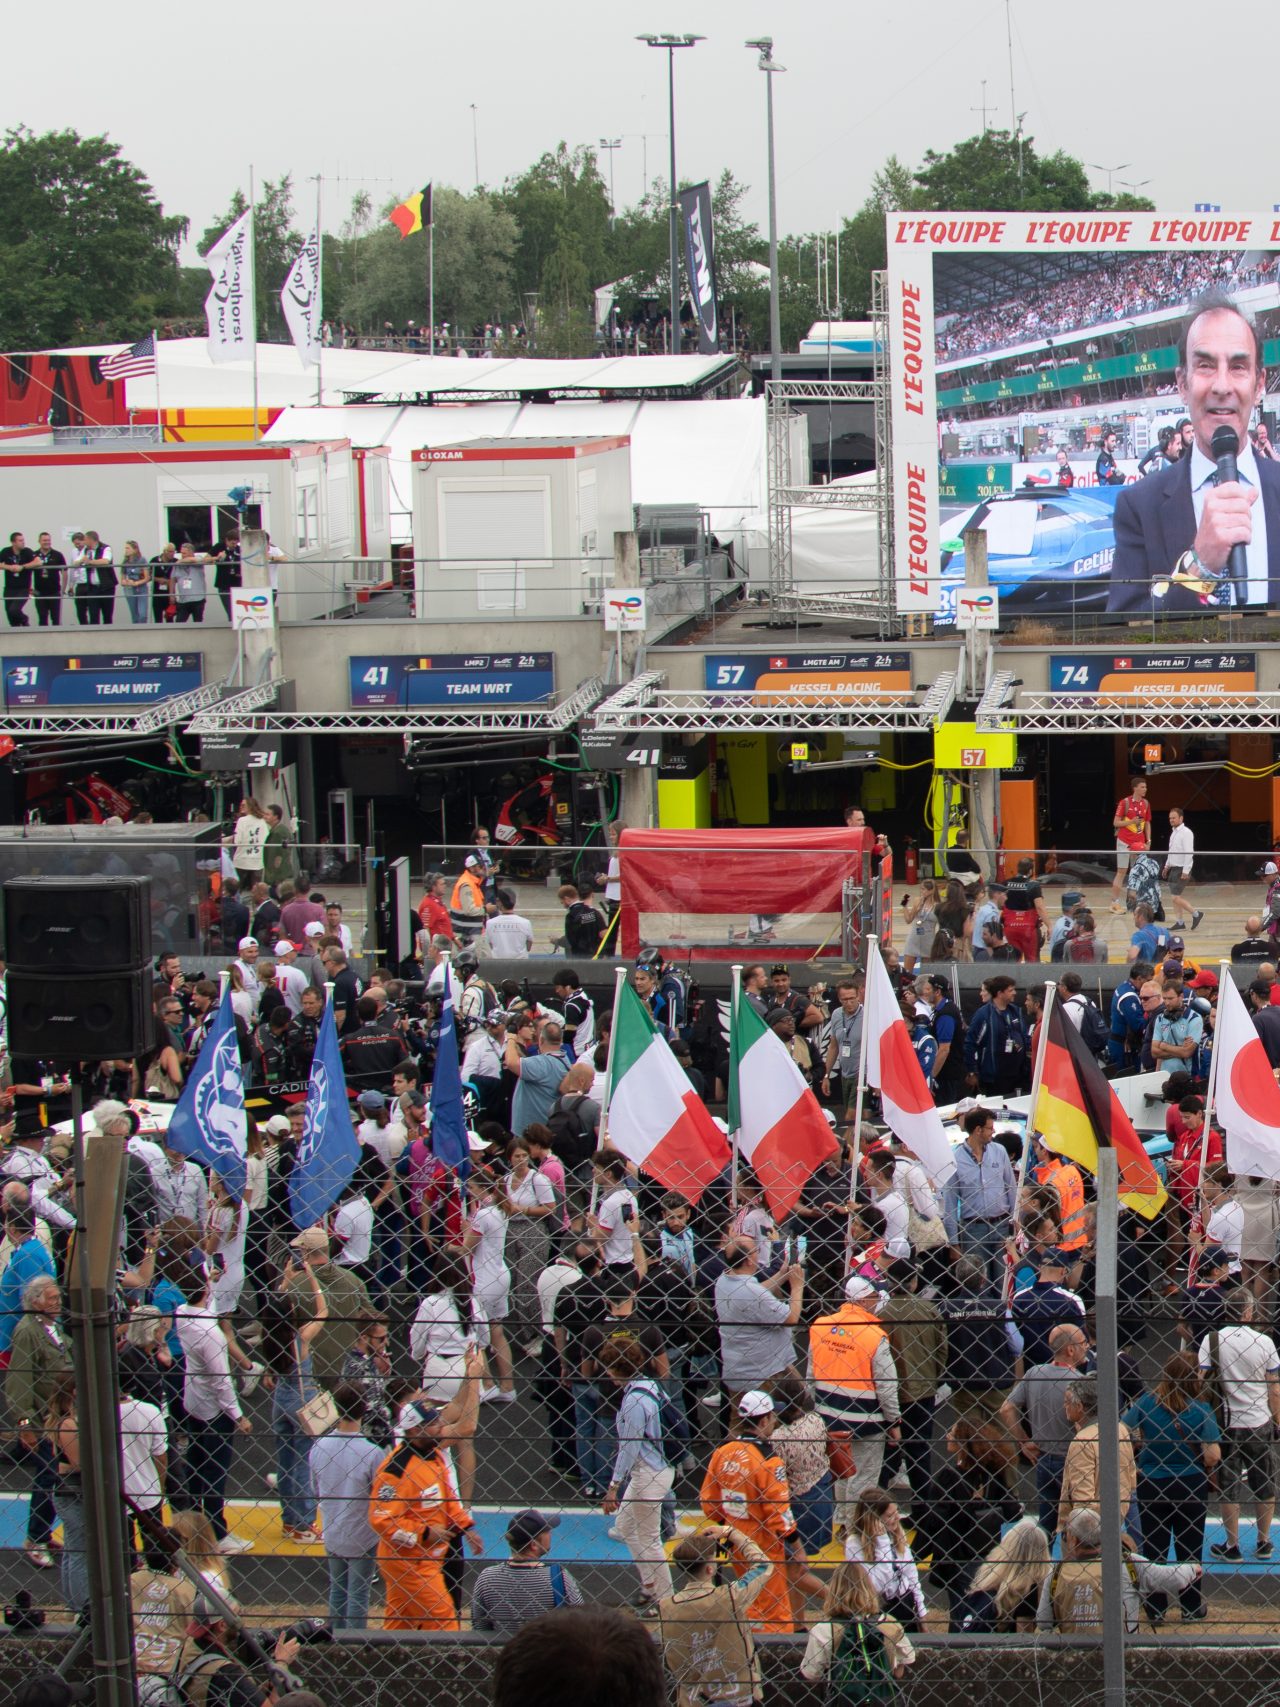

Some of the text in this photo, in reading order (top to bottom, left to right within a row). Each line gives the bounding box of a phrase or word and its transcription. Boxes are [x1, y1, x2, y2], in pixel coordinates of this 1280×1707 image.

[1134, 363, 1157, 373] ROLEX
[961, 614, 995, 622] Totanergies
[113, 659, 133, 667] LMP2
[464, 659, 484, 667] LMP2
[14, 667, 38, 686] 31
[363, 667, 389, 685] 41
[717, 666, 744, 684] 57
[1061, 666, 1089, 684] 74
[96, 682, 161, 695] TEAM WRT
[446, 683, 512, 694] TEAM WRT
[627, 749, 660, 766] 41
[794, 747, 805, 756] 57
[962, 750, 985, 766] 57
[1148, 748, 1158, 758] 74
[248, 751, 277, 767] 31
